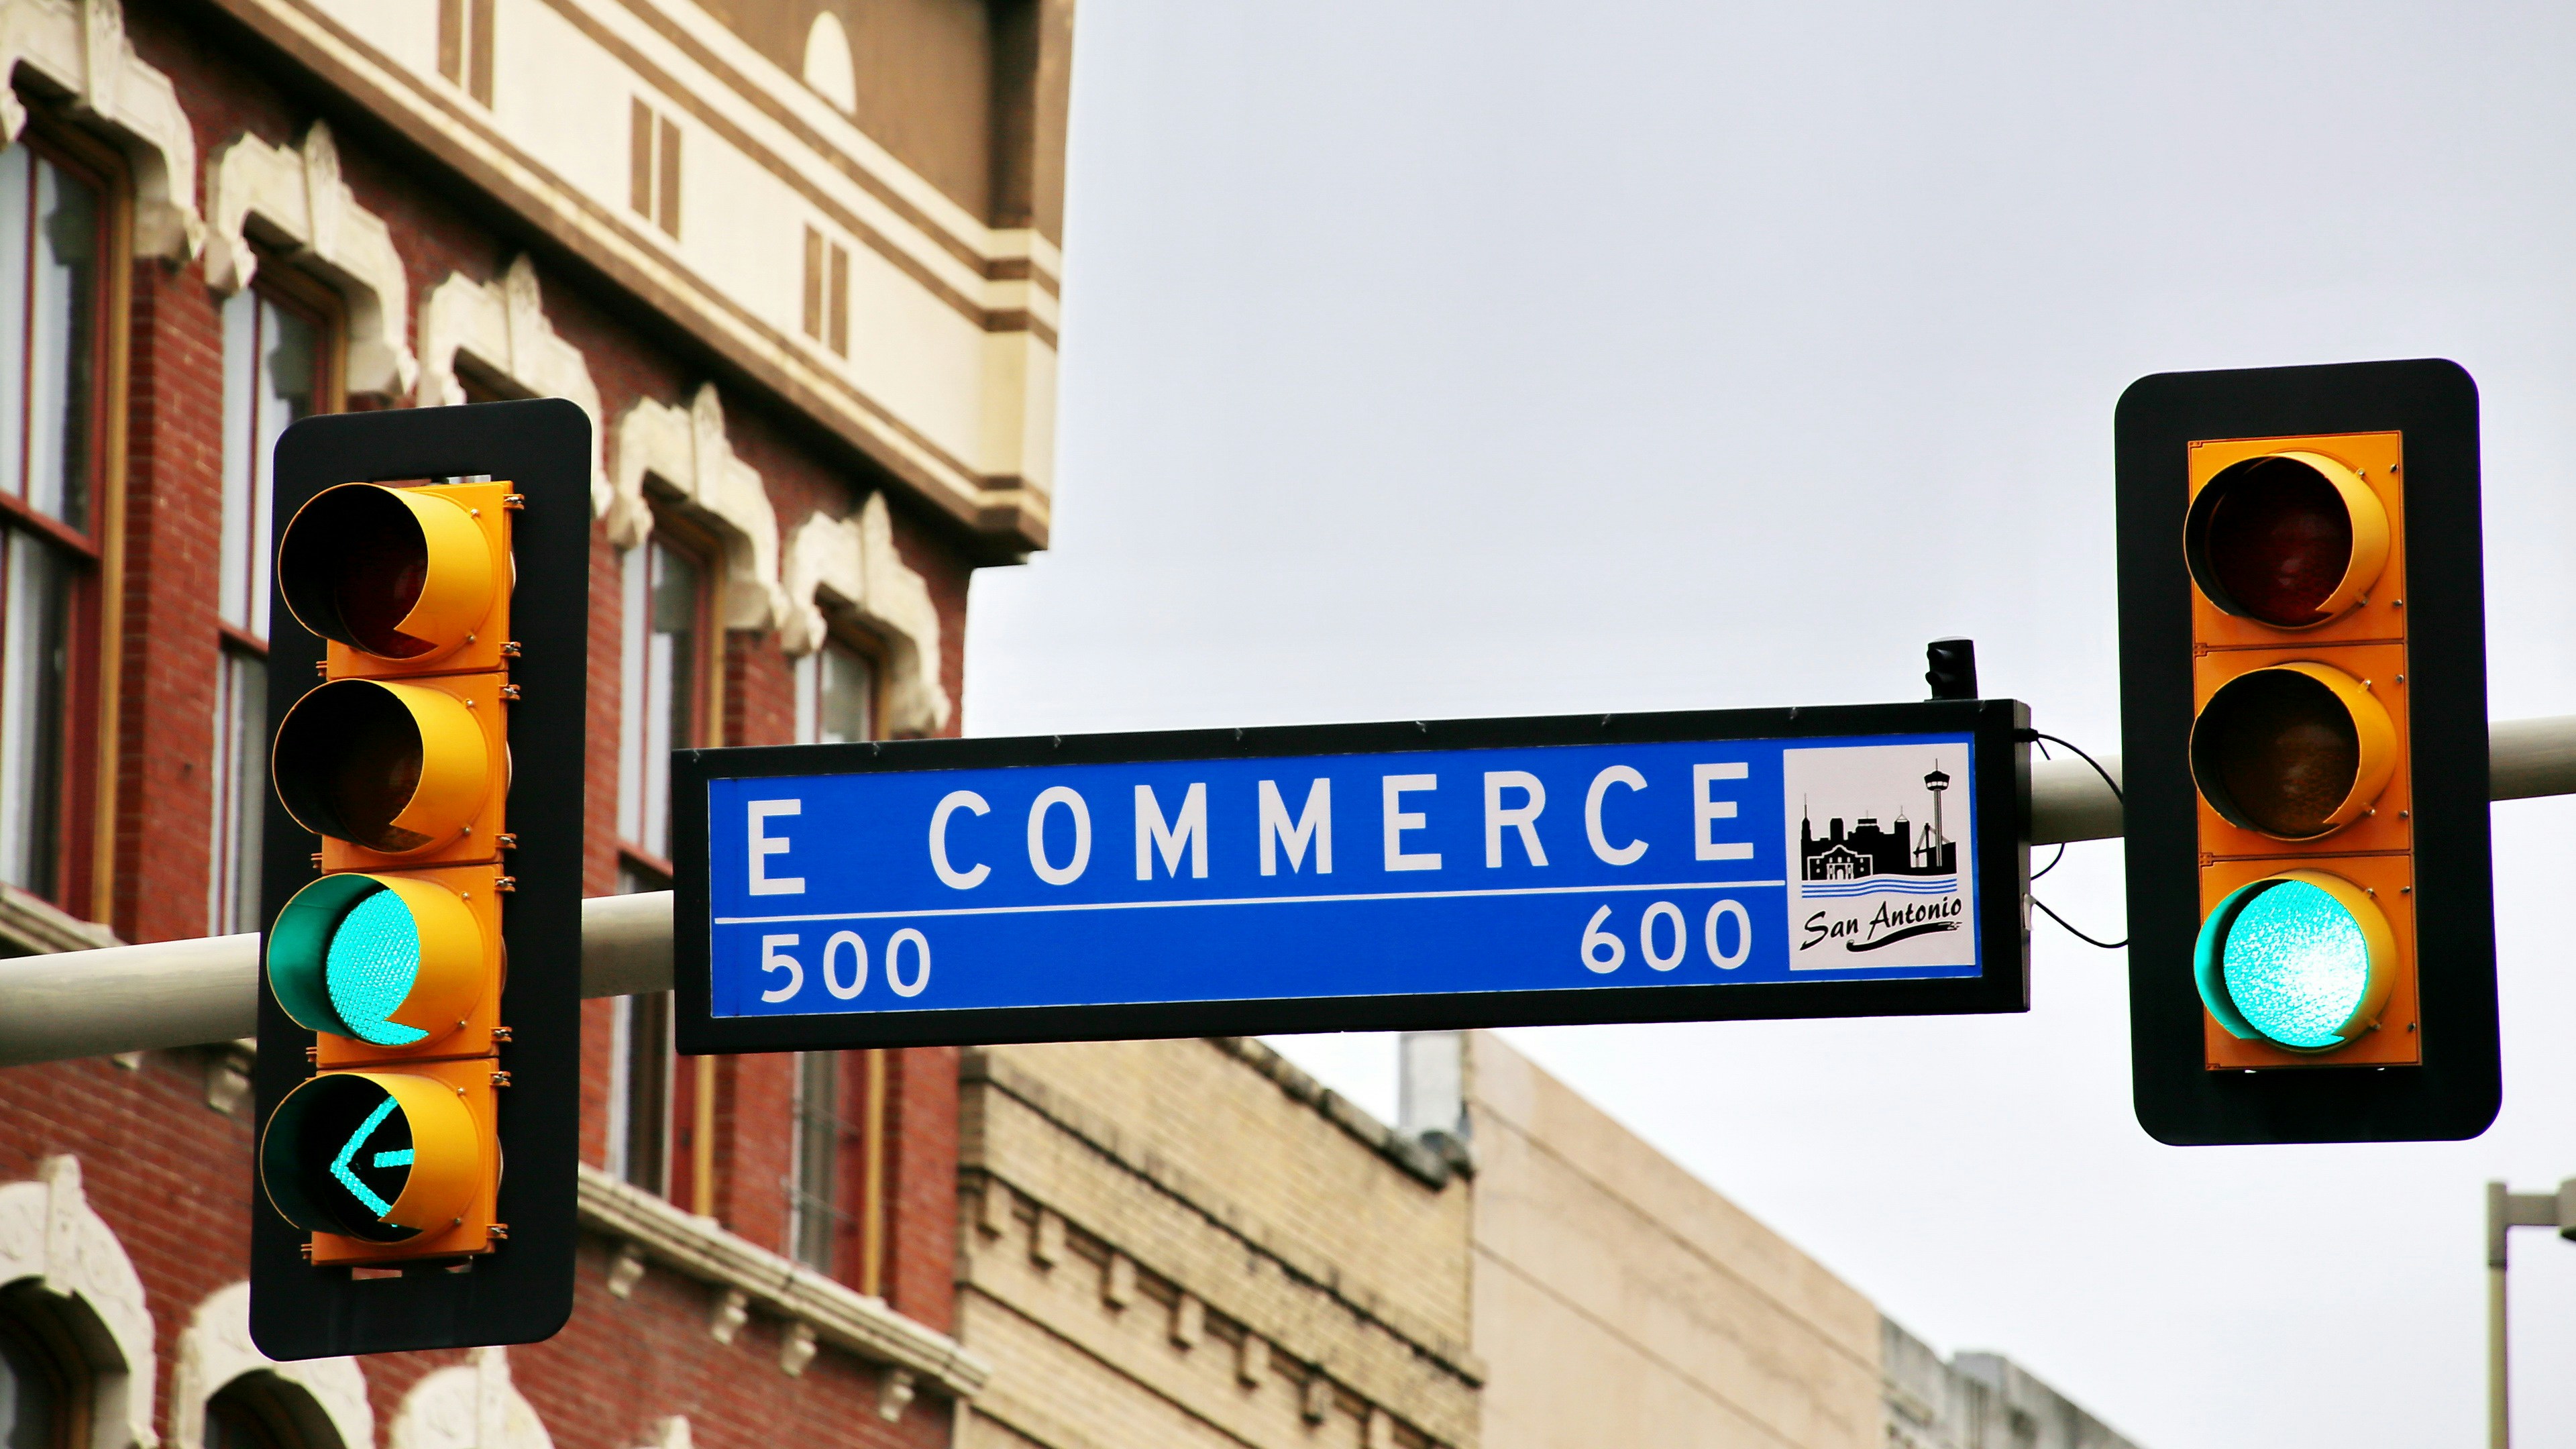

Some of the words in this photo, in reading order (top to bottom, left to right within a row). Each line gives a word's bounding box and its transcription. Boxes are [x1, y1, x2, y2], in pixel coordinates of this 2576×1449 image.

[748, 798, 806, 896] E
[928, 762, 1754, 890] COMMERCE
[1580, 899, 1752, 974] 600
[1799, 910, 1859, 951] San
[1867, 896, 1962, 941] Antonio
[761, 928, 931, 1003] 500
